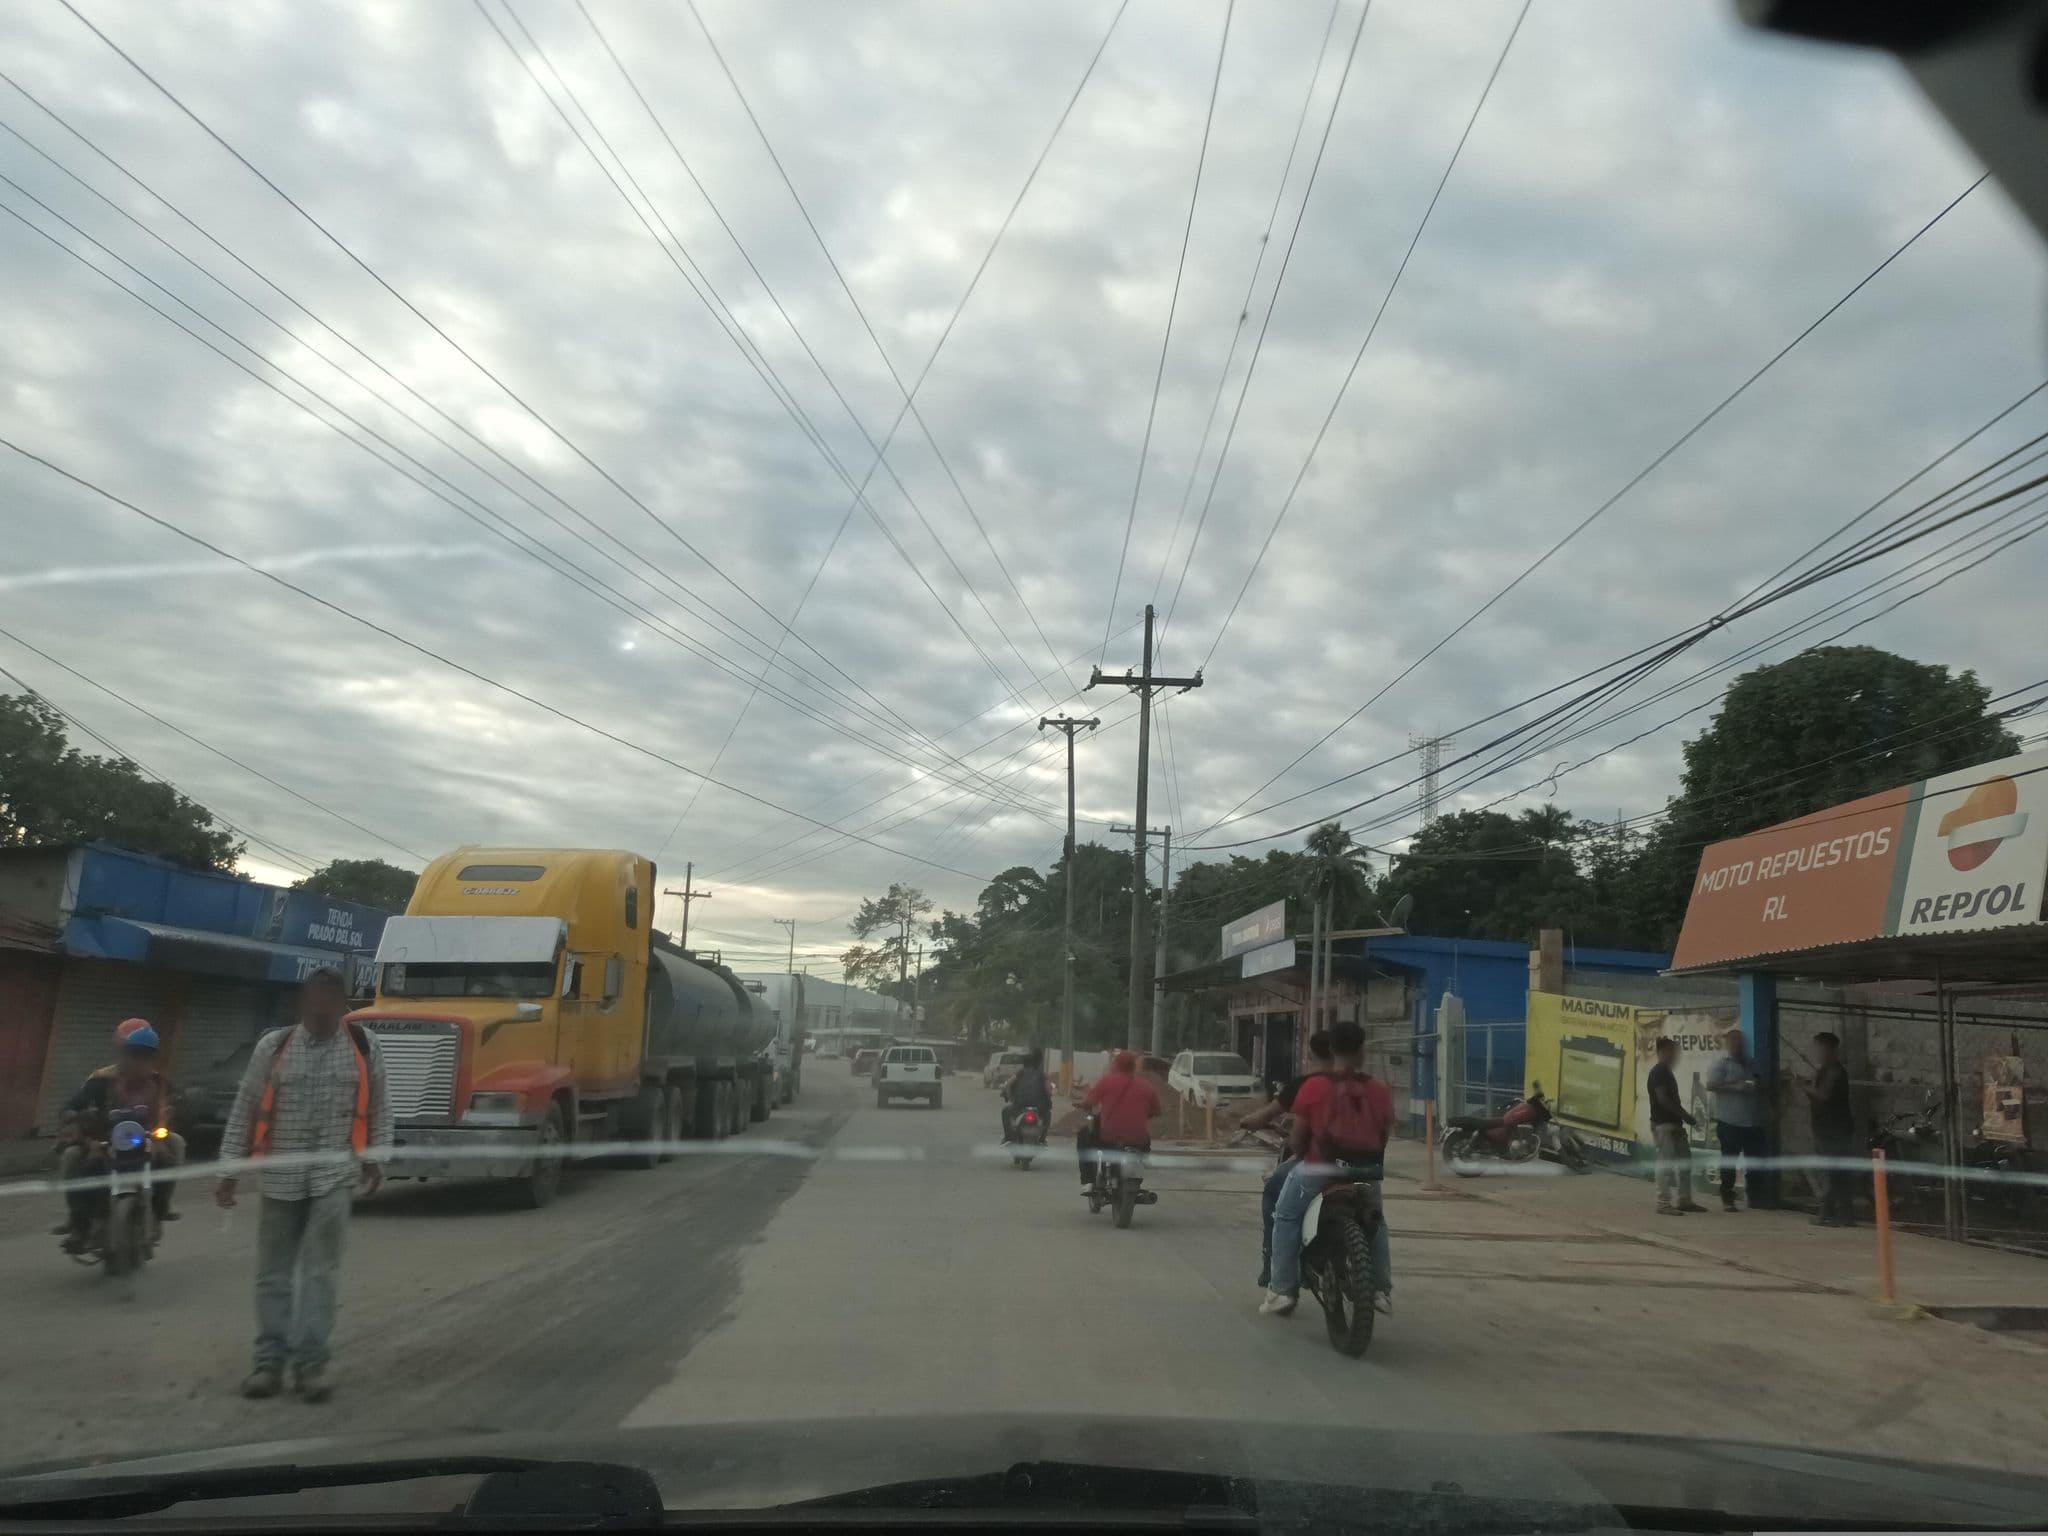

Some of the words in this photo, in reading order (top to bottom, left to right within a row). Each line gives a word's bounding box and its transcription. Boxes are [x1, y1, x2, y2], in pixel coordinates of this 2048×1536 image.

[1698, 860, 1754, 895] MOTO
[1756, 827, 1892, 881] REPUESTOS
[1762, 895, 1789, 922] RL
[1909, 882, 2027, 925] REPSOL
[327, 908, 353, 929] TIENDA
[307, 923, 335, 943] PRADO
[335, 929, 349, 945] DEL
[349, 931, 364, 947] SOL
[1561, 999, 1630, 1020] MAGNUM
